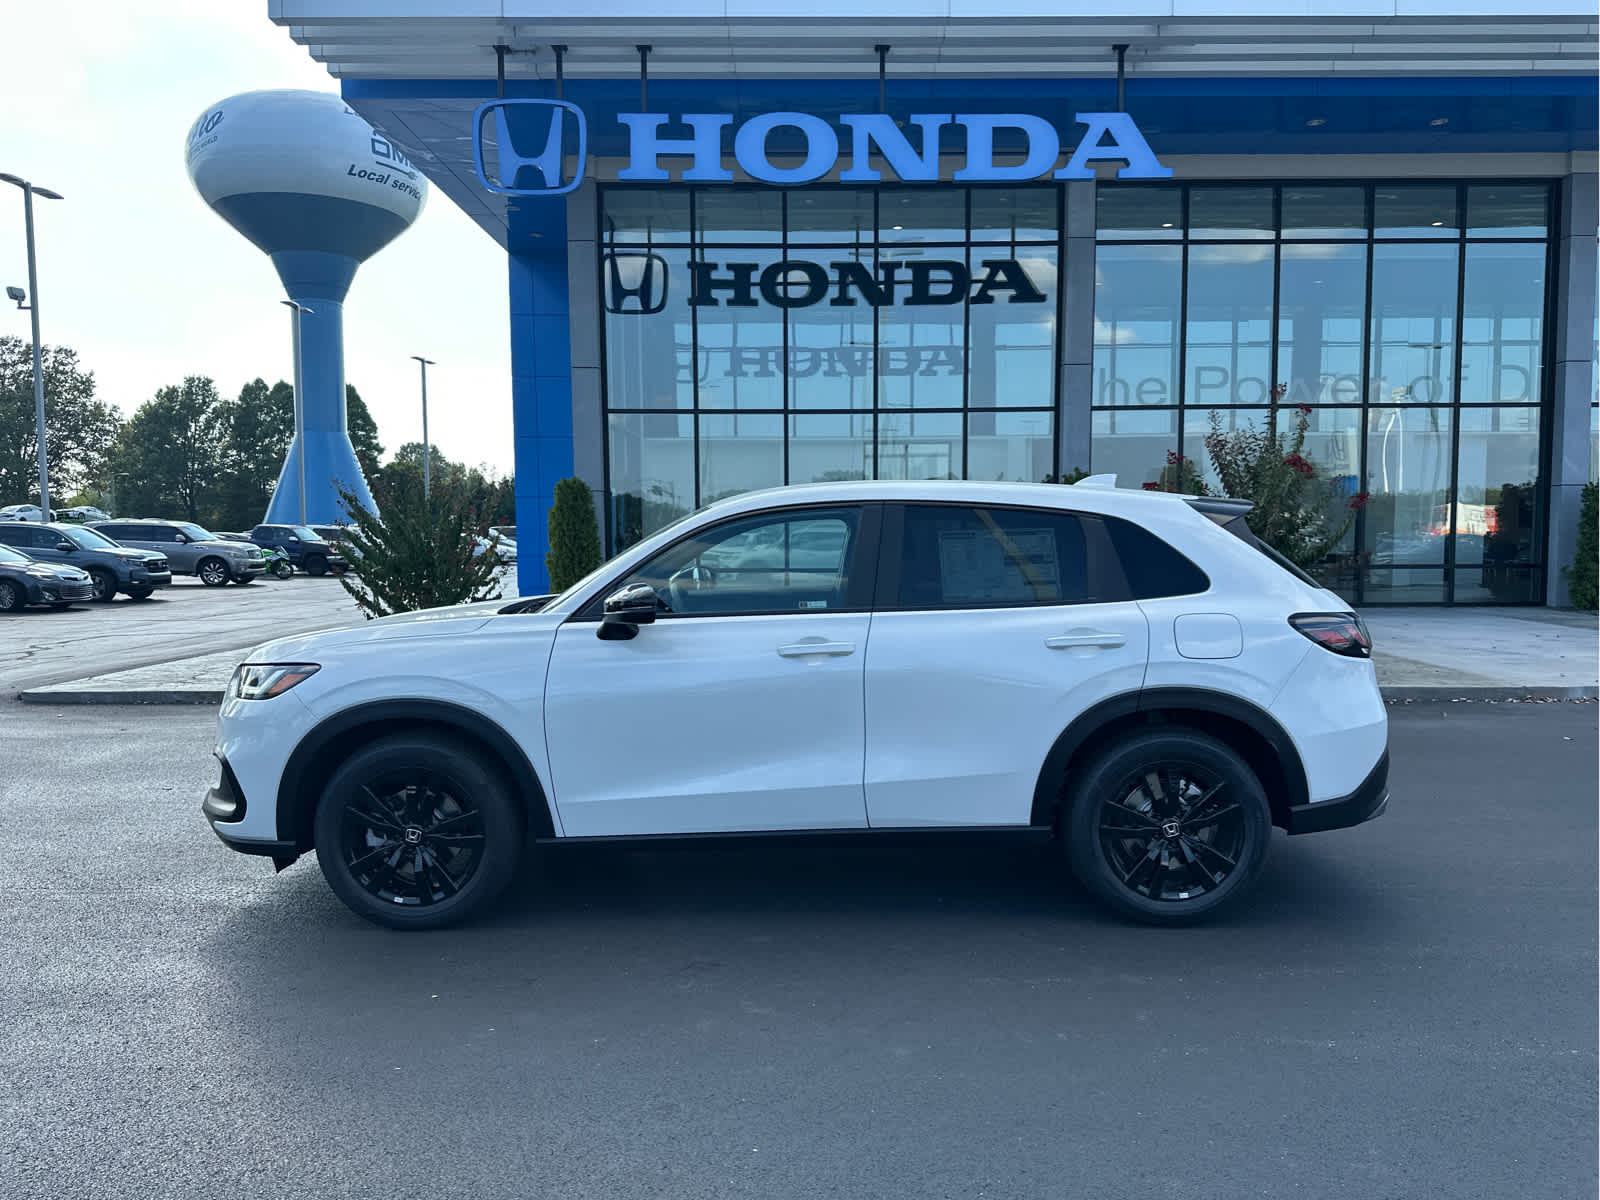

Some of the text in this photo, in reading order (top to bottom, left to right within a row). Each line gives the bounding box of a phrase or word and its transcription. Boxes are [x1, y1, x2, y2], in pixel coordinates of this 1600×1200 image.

[370, 138, 420, 173] OM
[617, 111, 1174, 185] HONDA
[347, 164, 391, 185] Local
[688, 260, 1047, 308] HONDA
[724, 347, 970, 378] HONDA
[1098, 368, 1169, 405] he
